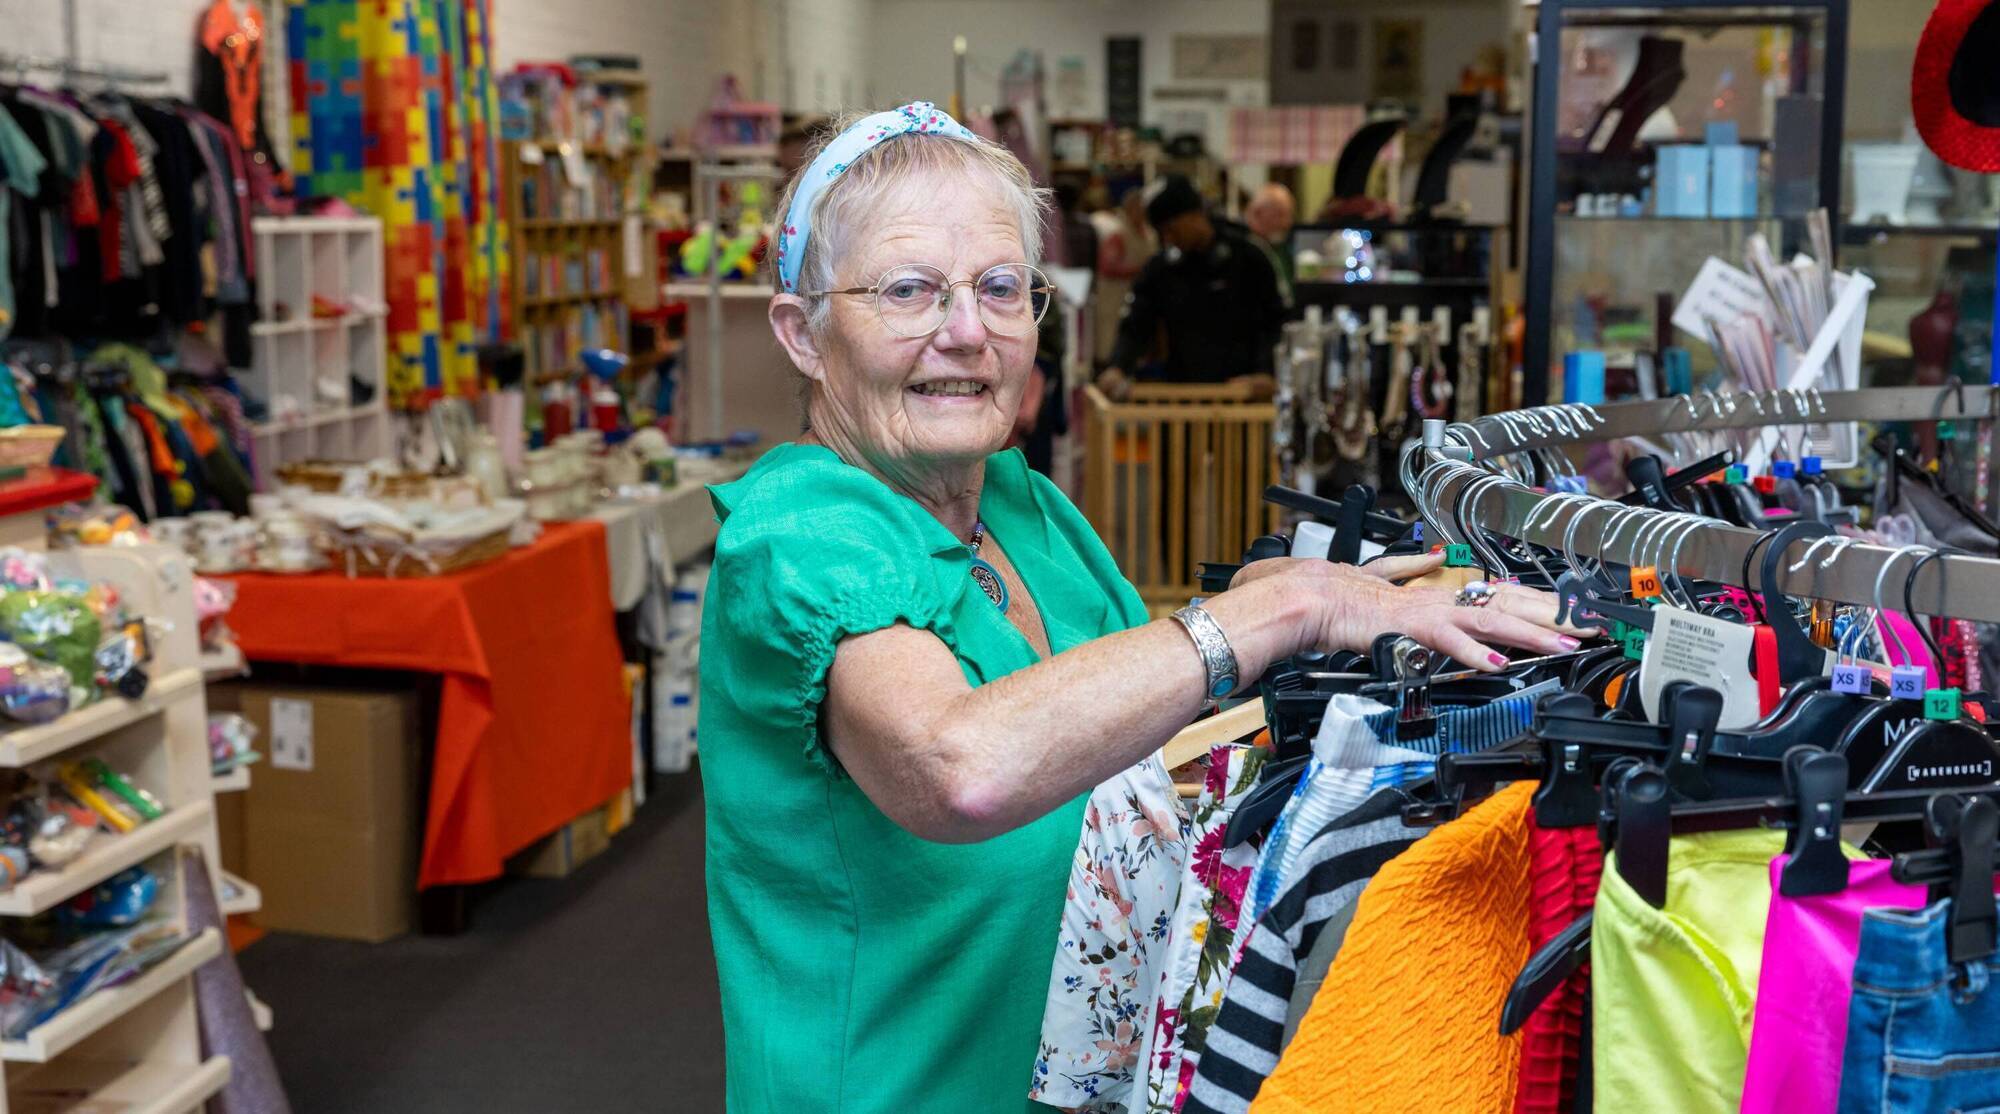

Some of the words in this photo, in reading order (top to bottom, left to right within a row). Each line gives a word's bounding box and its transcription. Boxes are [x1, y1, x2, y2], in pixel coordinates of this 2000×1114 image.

[1455, 549, 1467, 560] M
[1638, 579, 1655, 592] 10
[1670, 617, 1701, 633] MULTIWAY
[1702, 625, 1716, 638] BRA
[1631, 637, 1644, 652] 12
[1836, 673, 1855, 685] XS
[1895, 680, 1915, 693] XS
[1932, 700, 1949, 713] 12
